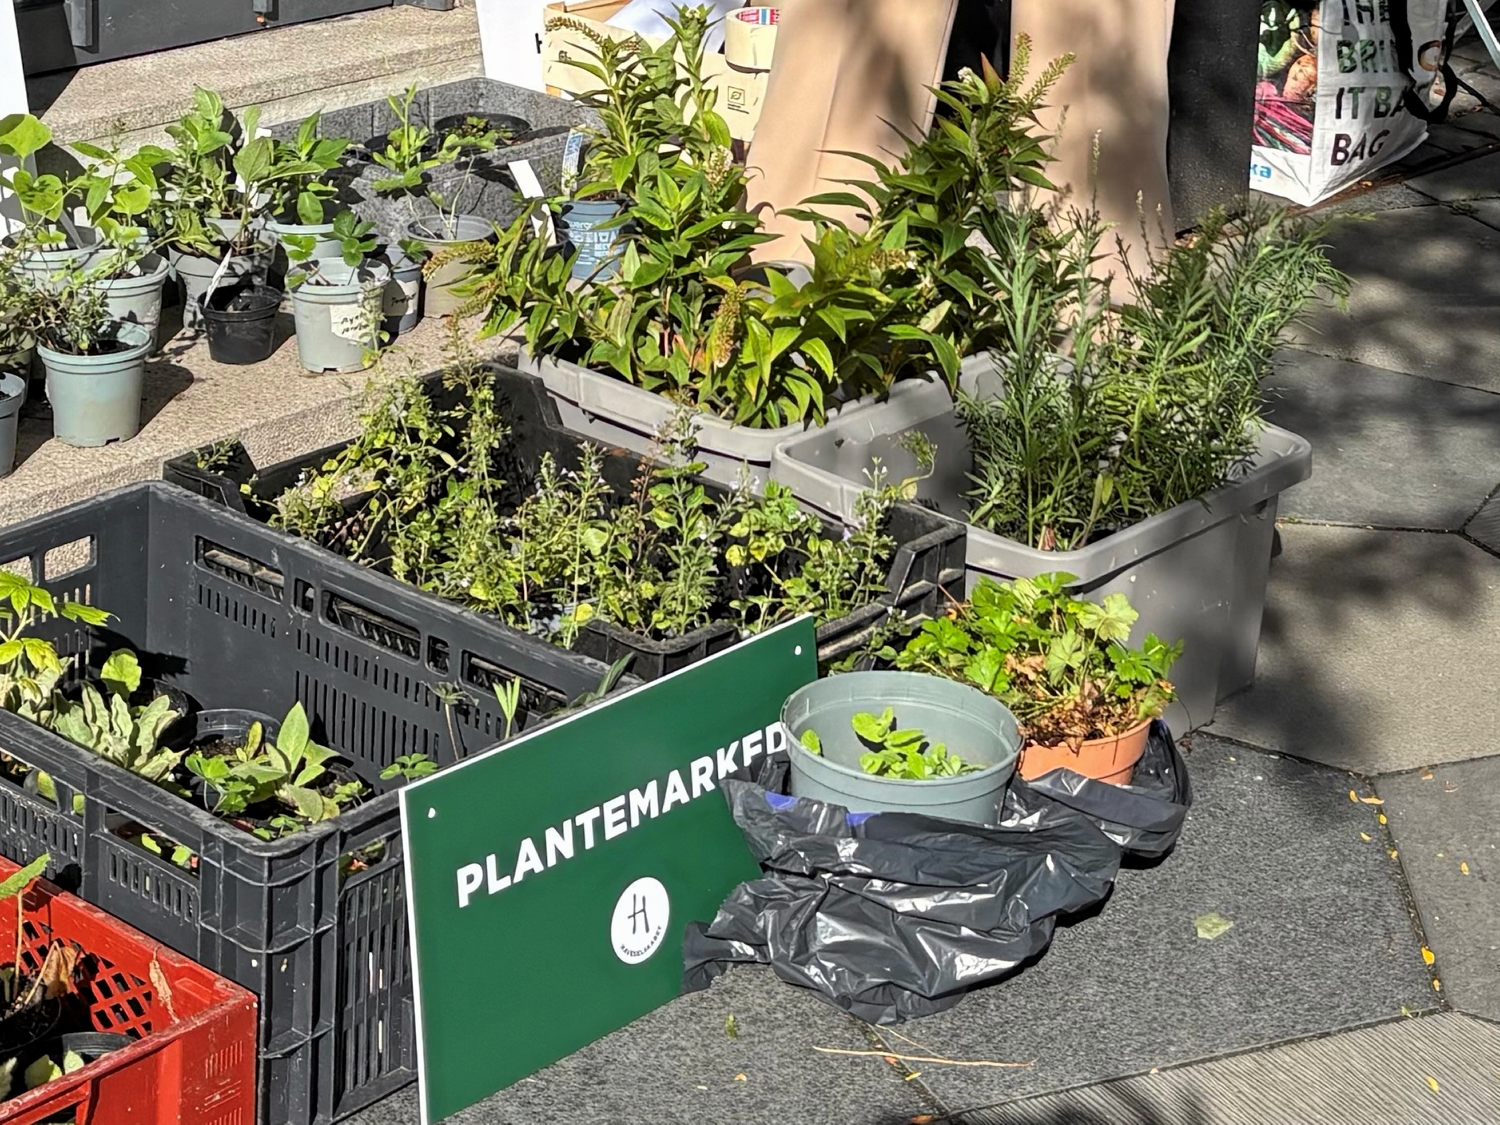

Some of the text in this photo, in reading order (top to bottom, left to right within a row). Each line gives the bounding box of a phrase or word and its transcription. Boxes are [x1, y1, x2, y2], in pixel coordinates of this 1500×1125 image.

[1335, 86, 1366, 120] IT
[1331, 129, 1390, 167] BAG
[627, 893, 650, 935] H
